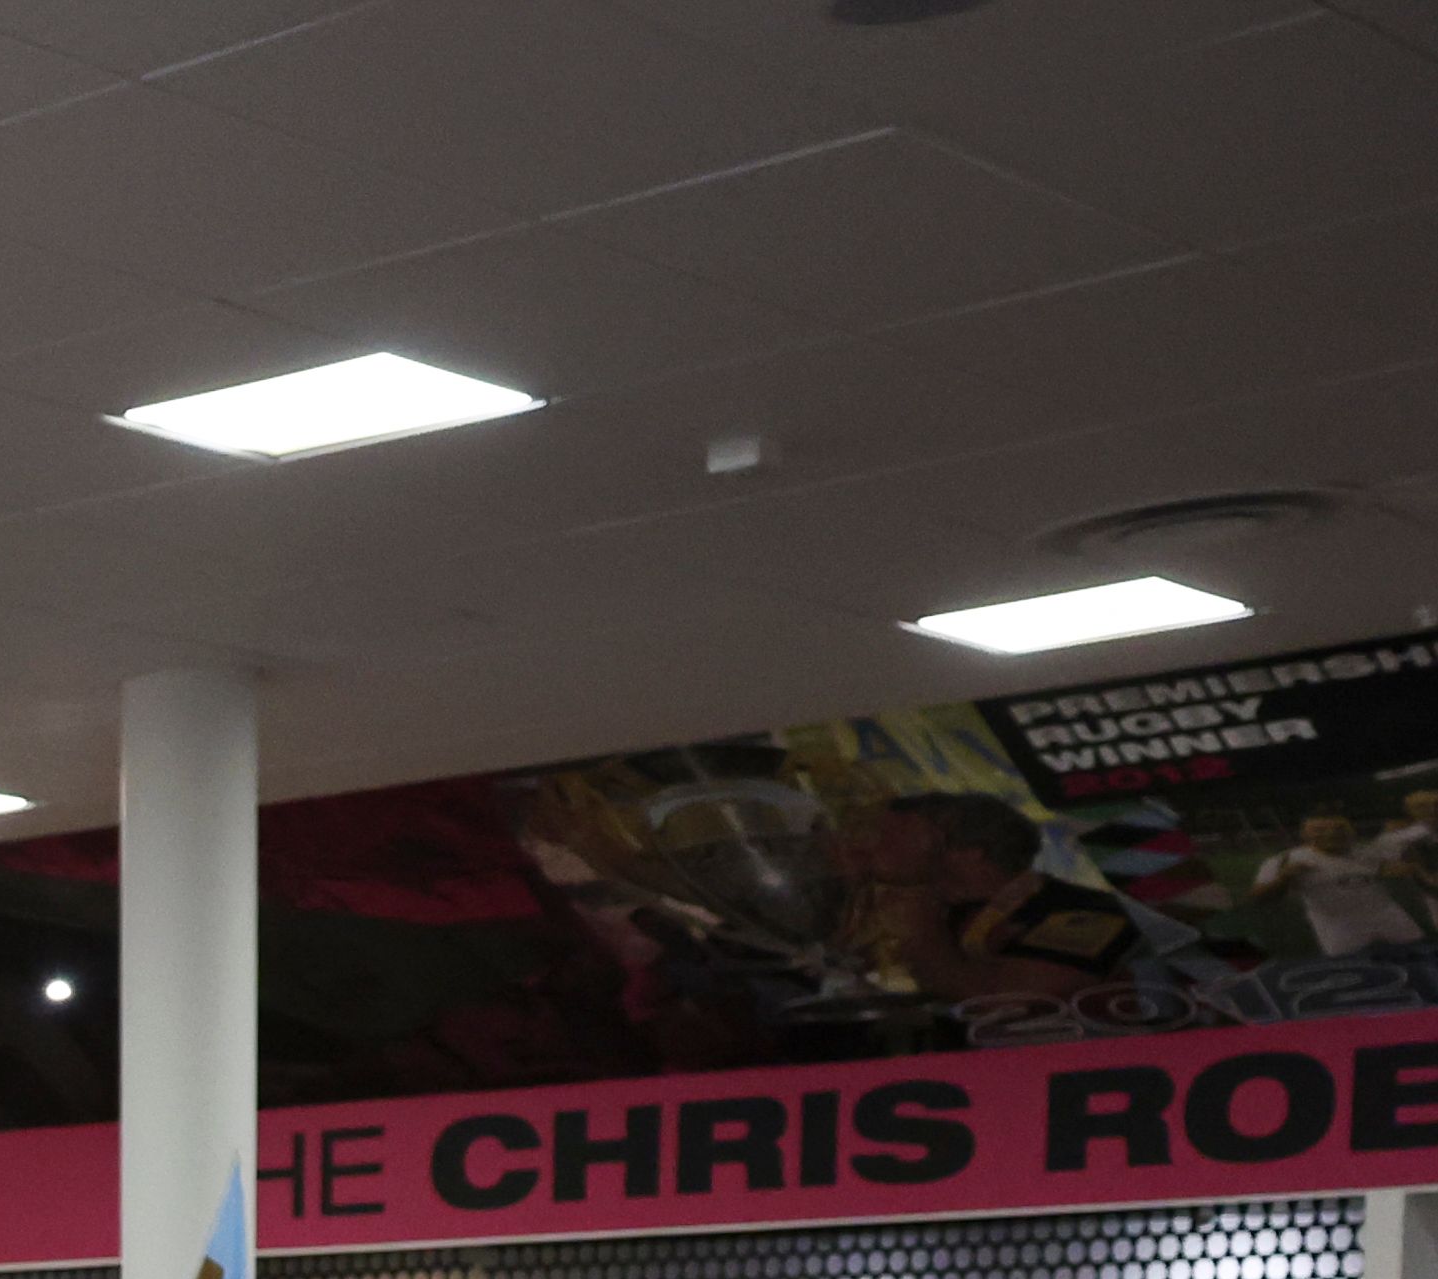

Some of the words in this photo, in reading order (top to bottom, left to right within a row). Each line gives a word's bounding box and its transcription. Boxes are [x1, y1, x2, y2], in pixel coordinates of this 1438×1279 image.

[1008, 637, 1438, 727] PREMIERSH
[1023, 695, 1263, 750] RUGBY
[1038, 717, 1319, 774] WINNER
[429, 1079, 976, 1214] CHRIS
